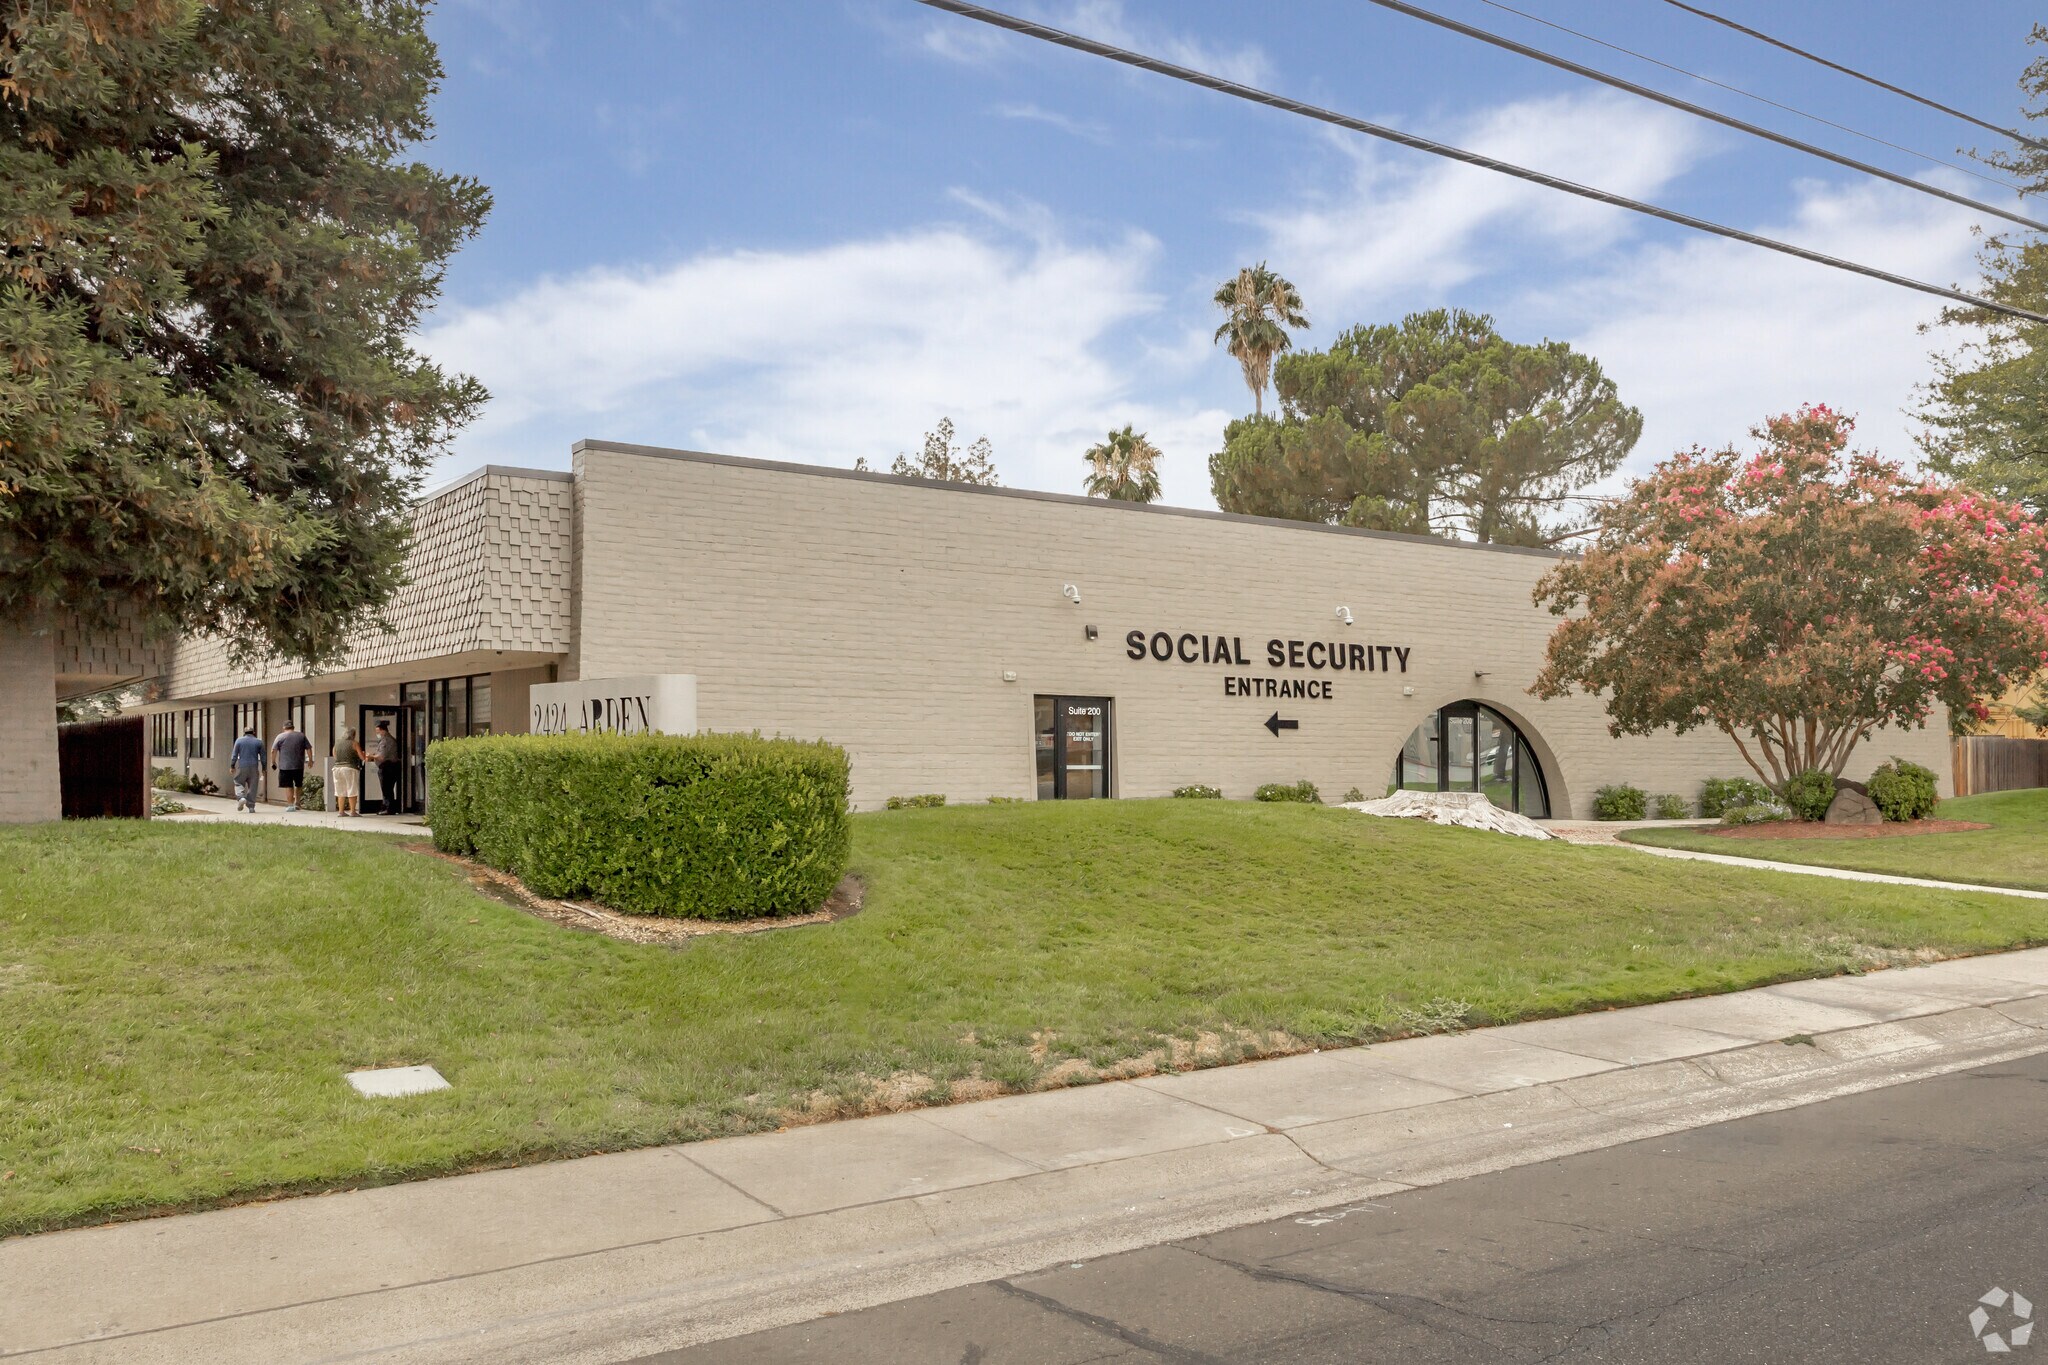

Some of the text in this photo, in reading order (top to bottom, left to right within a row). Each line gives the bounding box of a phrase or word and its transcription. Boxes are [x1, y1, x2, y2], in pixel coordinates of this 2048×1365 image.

[1126, 630, 1411, 673] SOCIAL SECURITY
[1224, 676, 1333, 699] ENTRANCE
[534, 696, 651, 738] 2424 ARDEN
[1068, 706, 1101, 716] Suite 200
